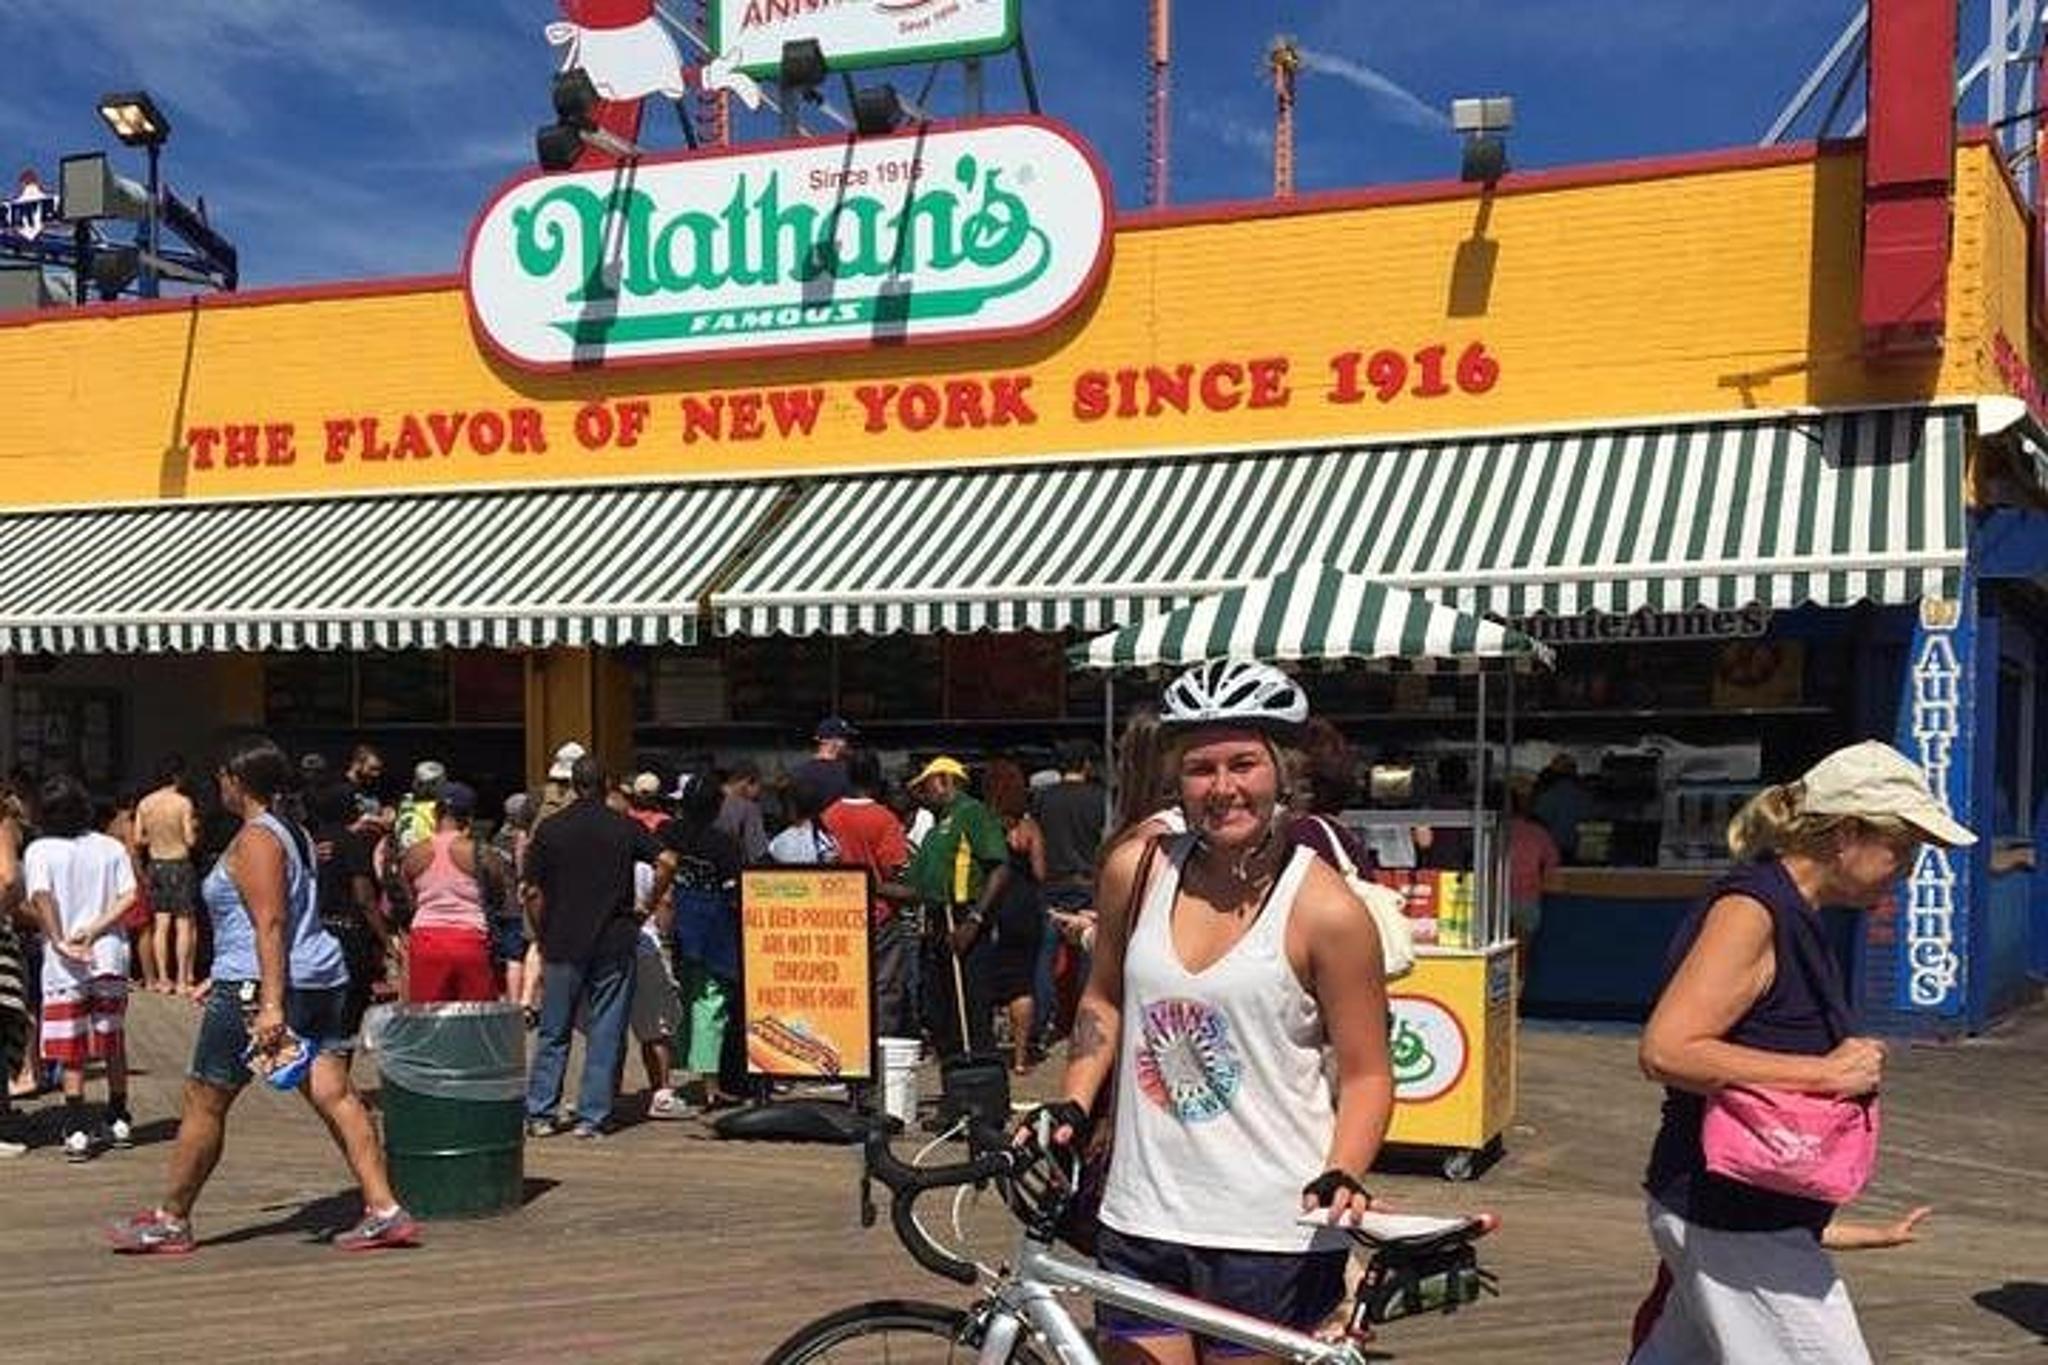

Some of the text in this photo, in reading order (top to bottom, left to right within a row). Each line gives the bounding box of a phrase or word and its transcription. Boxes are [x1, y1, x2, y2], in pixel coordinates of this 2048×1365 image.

[511, 153, 1050, 304] Nathan's
[808, 159, 924, 190] Since 1916
[689, 302, 863, 332] FAMOUS
[186, 341, 1500, 471] THE FLAVOR OF NEW YORK SINCE 1916
[1912, 632, 1962, 820] Aunti
